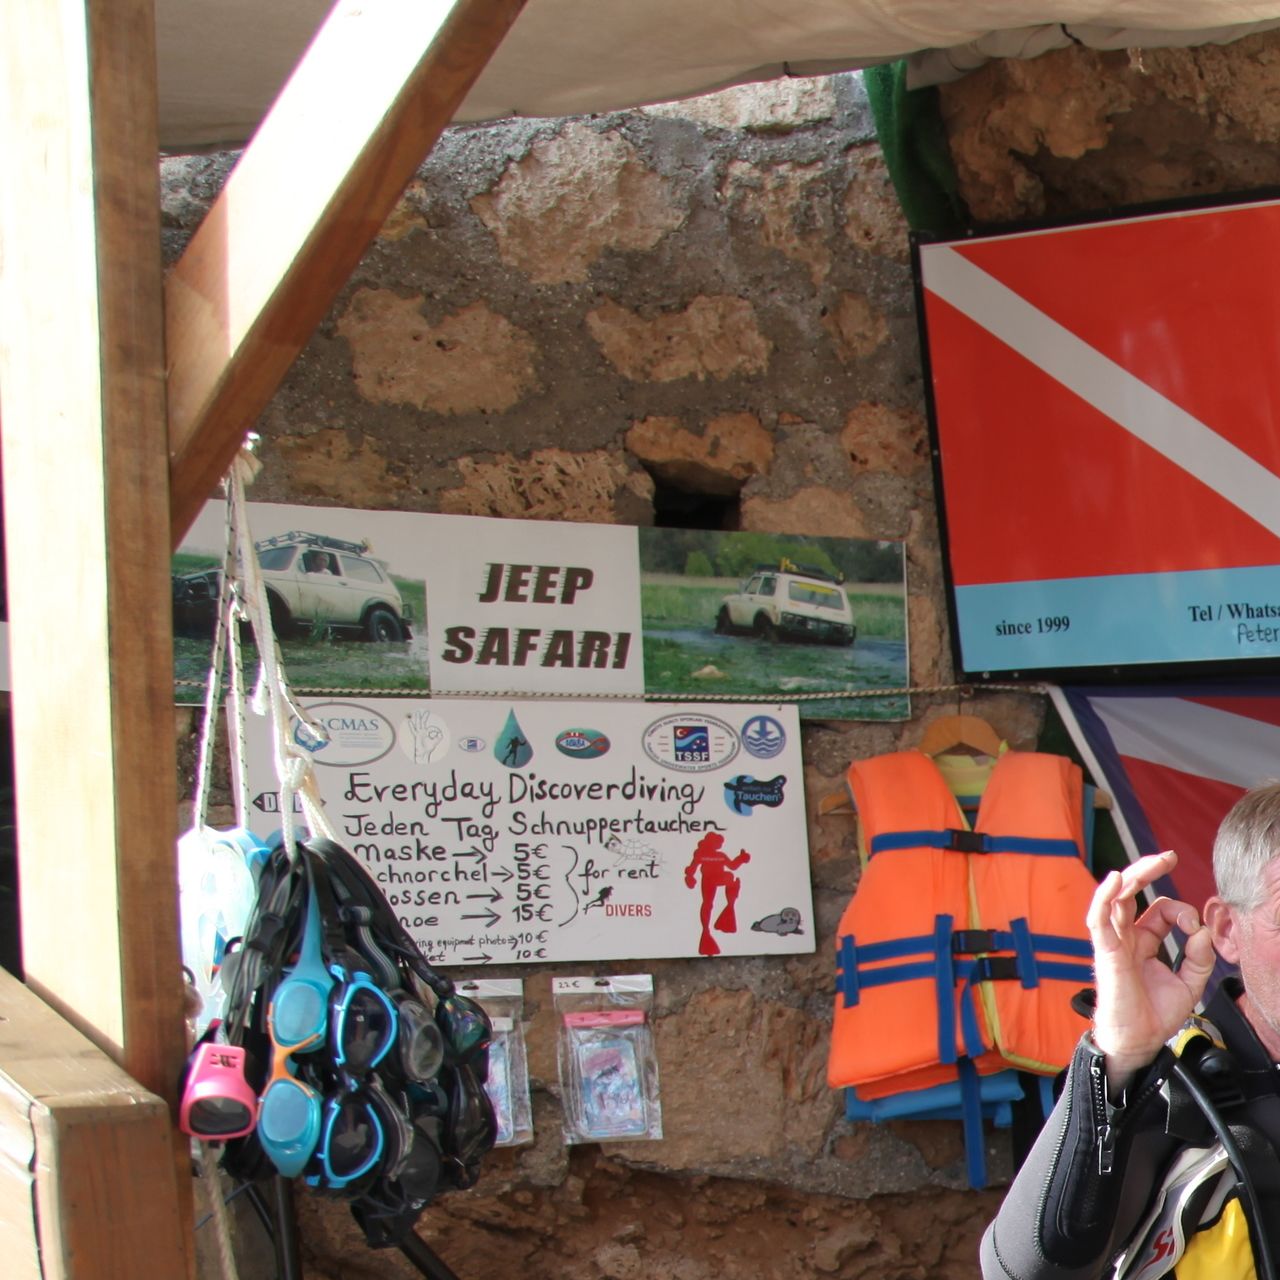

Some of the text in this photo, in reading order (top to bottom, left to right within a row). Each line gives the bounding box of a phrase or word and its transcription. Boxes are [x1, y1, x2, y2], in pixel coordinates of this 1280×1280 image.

[479, 561, 594, 605] JEEP
[1188, 604, 1213, 622] Tel
[995, 615, 1070, 637] since 1999
[1237, 623, 1280, 644] Peter
[442, 625, 632, 670] SAFARI
[327, 718, 379, 731] CMAS
[676, 751, 710, 762] TSSF
[344, 769, 502, 819] Everyday
[509, 765, 705, 814] Discoverdiving
[737, 791, 780, 803] Tauchen
[343, 808, 727, 852] Jeden Tag Schnuppertauchen
[354, 838, 447, 862] Maske
[377, 861, 488, 884] chnorchel
[578, 859, 611, 896] for
[617, 861, 661, 880] rent
[605, 903, 653, 918] DIVERS
[478, 934, 507, 948] photo
